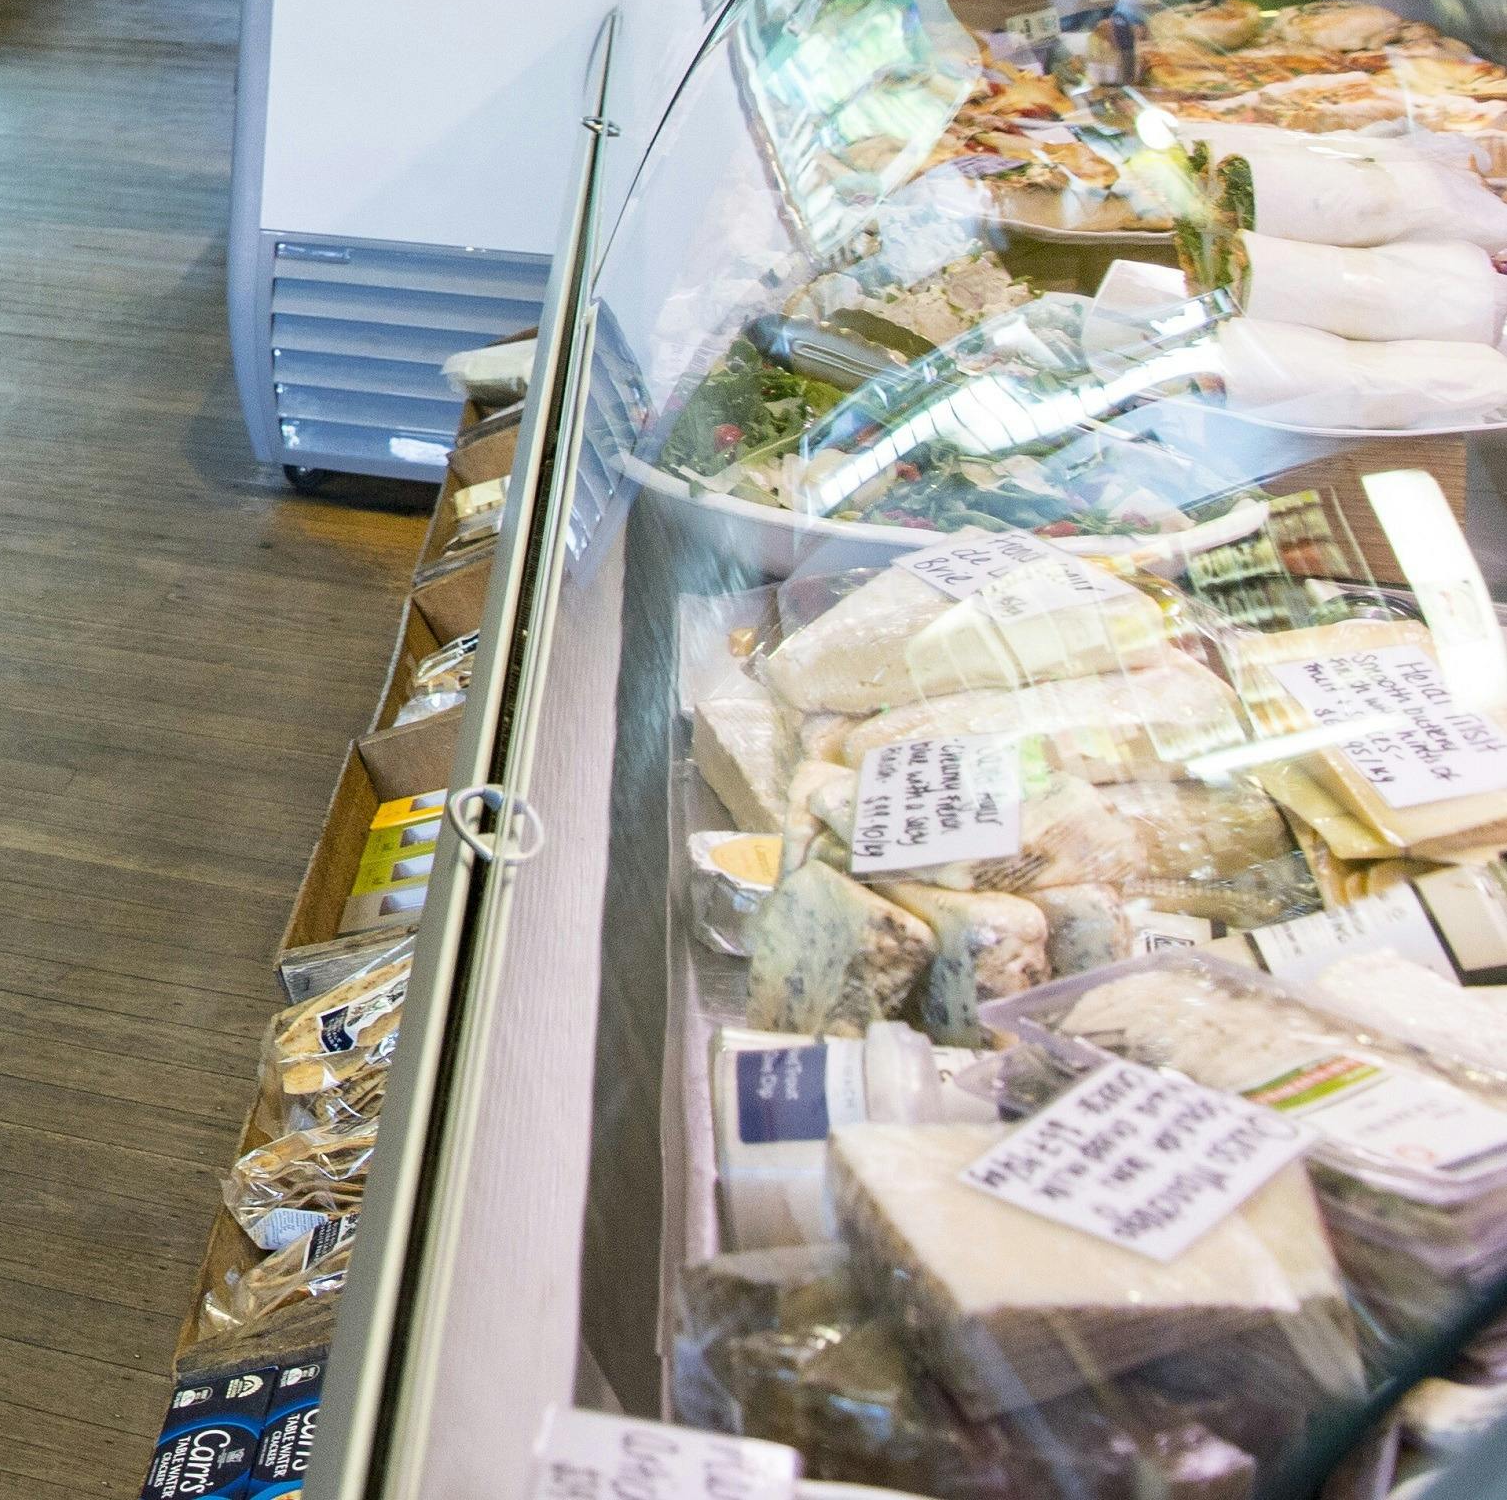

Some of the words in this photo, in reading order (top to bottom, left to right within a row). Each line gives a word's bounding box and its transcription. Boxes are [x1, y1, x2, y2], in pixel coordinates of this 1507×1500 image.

[913, 557, 974, 585] Brie
[284, 1414, 301, 1442] TABLE
[171, 1435, 192, 1464] TABLE
[179, 1429, 231, 1495] Carr's
[265, 1431, 282, 1467] CRACKERS
[273, 1443, 294, 1479] WATER
[154, 1452, 172, 1488] CRACKERS
[161, 1464, 183, 1500] WATER
